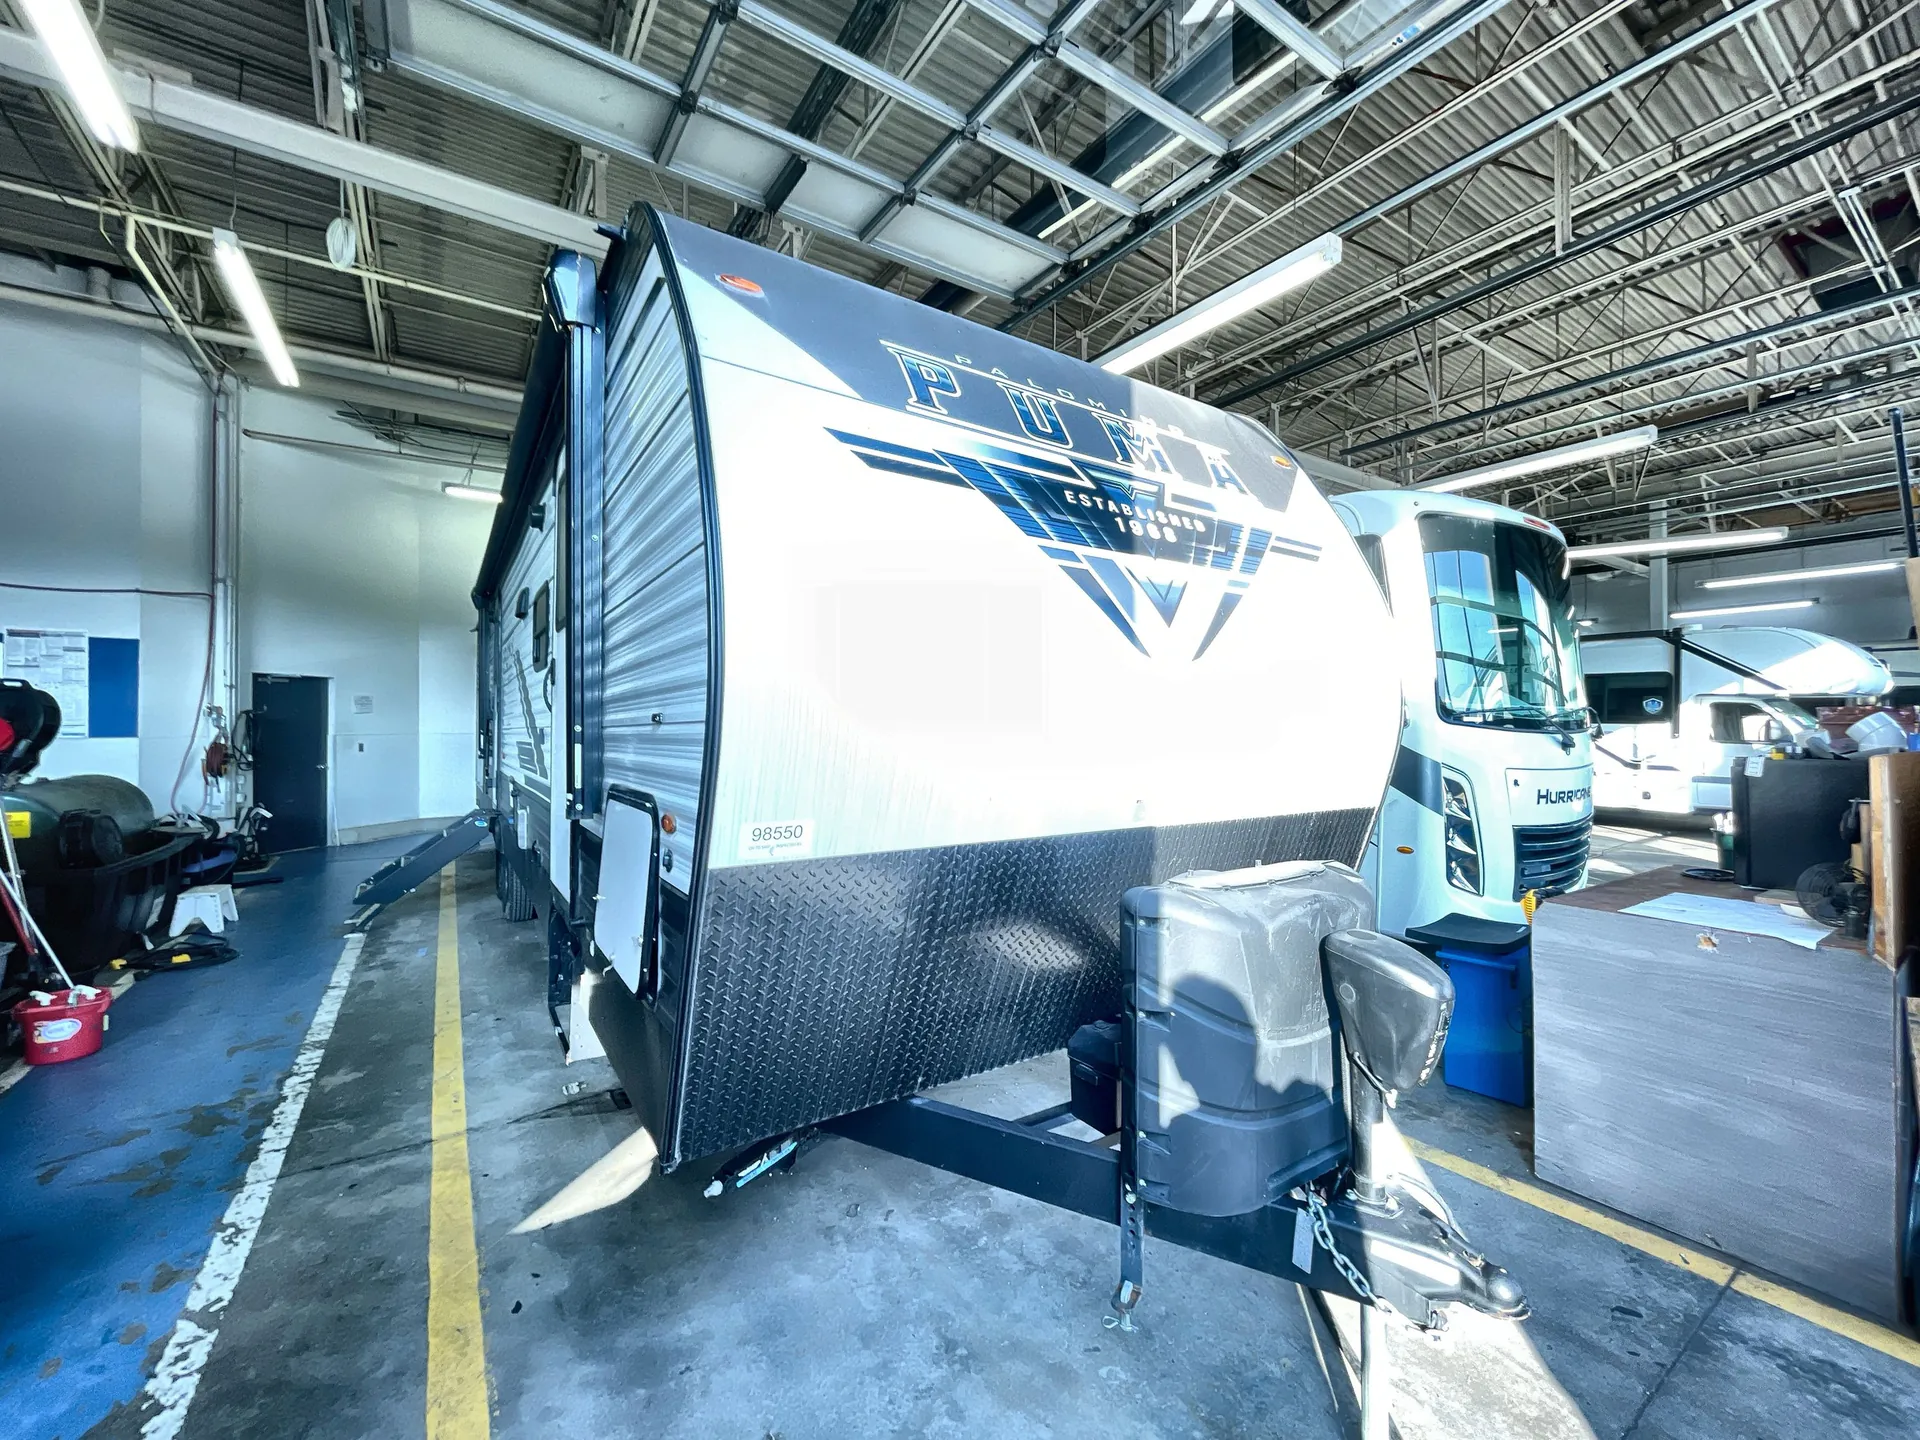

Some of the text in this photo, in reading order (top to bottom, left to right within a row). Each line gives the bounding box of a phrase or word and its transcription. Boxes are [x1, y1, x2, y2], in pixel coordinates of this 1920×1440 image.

[888, 341, 1254, 500] PUMA
[1063, 489, 1206, 533] ESTABLISHED
[751, 824, 804, 842] 98550
